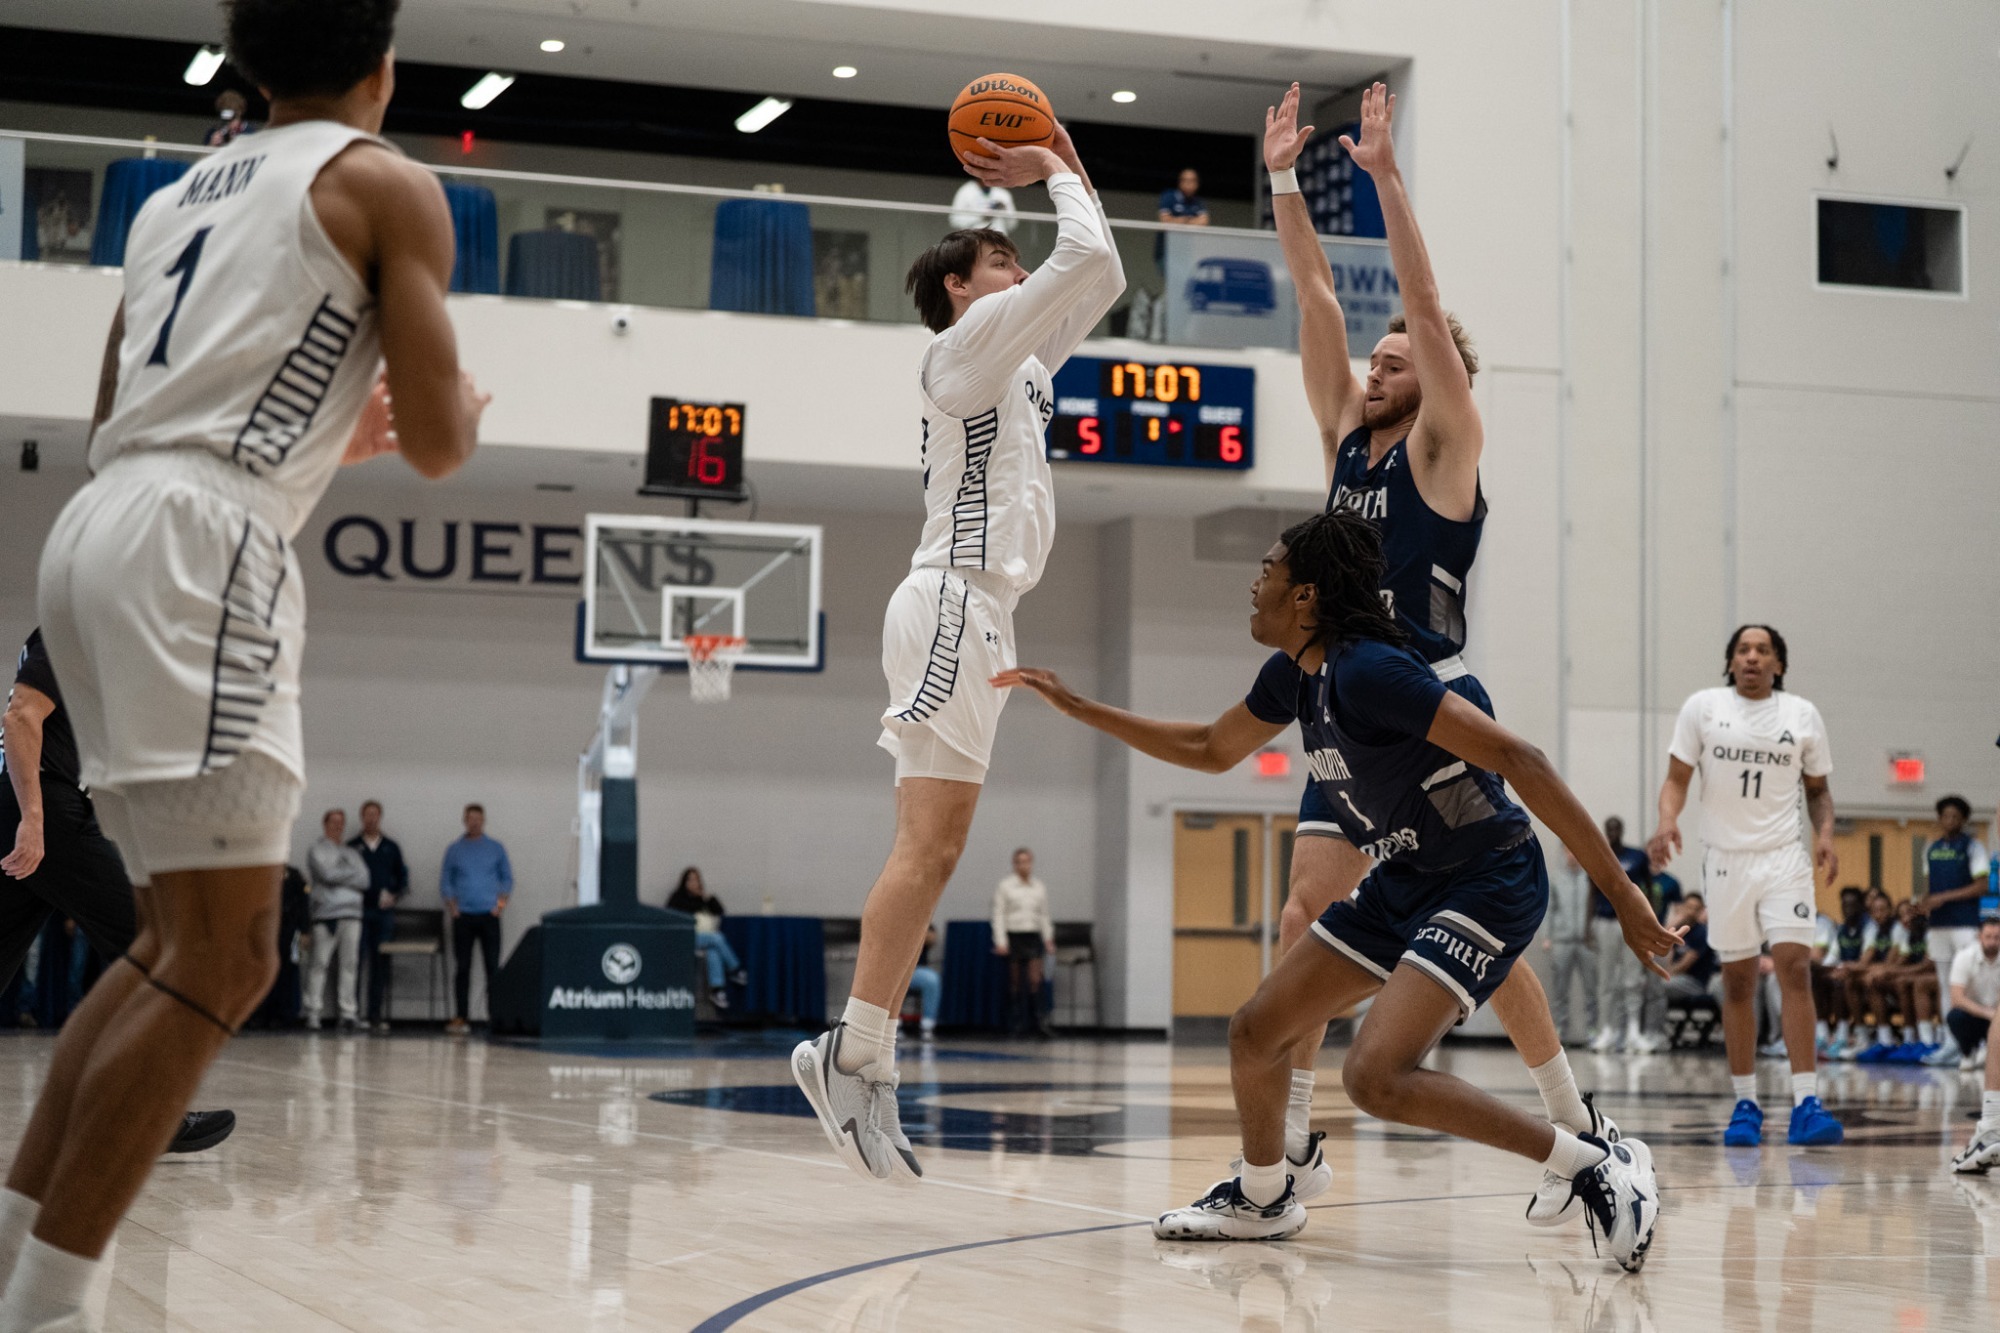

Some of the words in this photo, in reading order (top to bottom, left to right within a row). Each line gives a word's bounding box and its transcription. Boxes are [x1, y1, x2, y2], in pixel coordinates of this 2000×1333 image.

[970, 80, 1039, 104] Wilson
[980, 112, 1023, 128] EVO
[177, 155, 267, 208] MANN
[145, 223, 215, 368] 1
[669, 404, 740, 436] 17:07
[1078, 417, 1101, 454] 5
[688, 436, 726, 485] 16
[1220, 426, 1243, 463] 6
[1713, 746, 1793, 767] QUEENS
[1739, 769, 1763, 799] 11
[1338, 790, 1375, 831] 1
[549, 985, 625, 1010] Atrium
[626, 985, 695, 1010] Health
